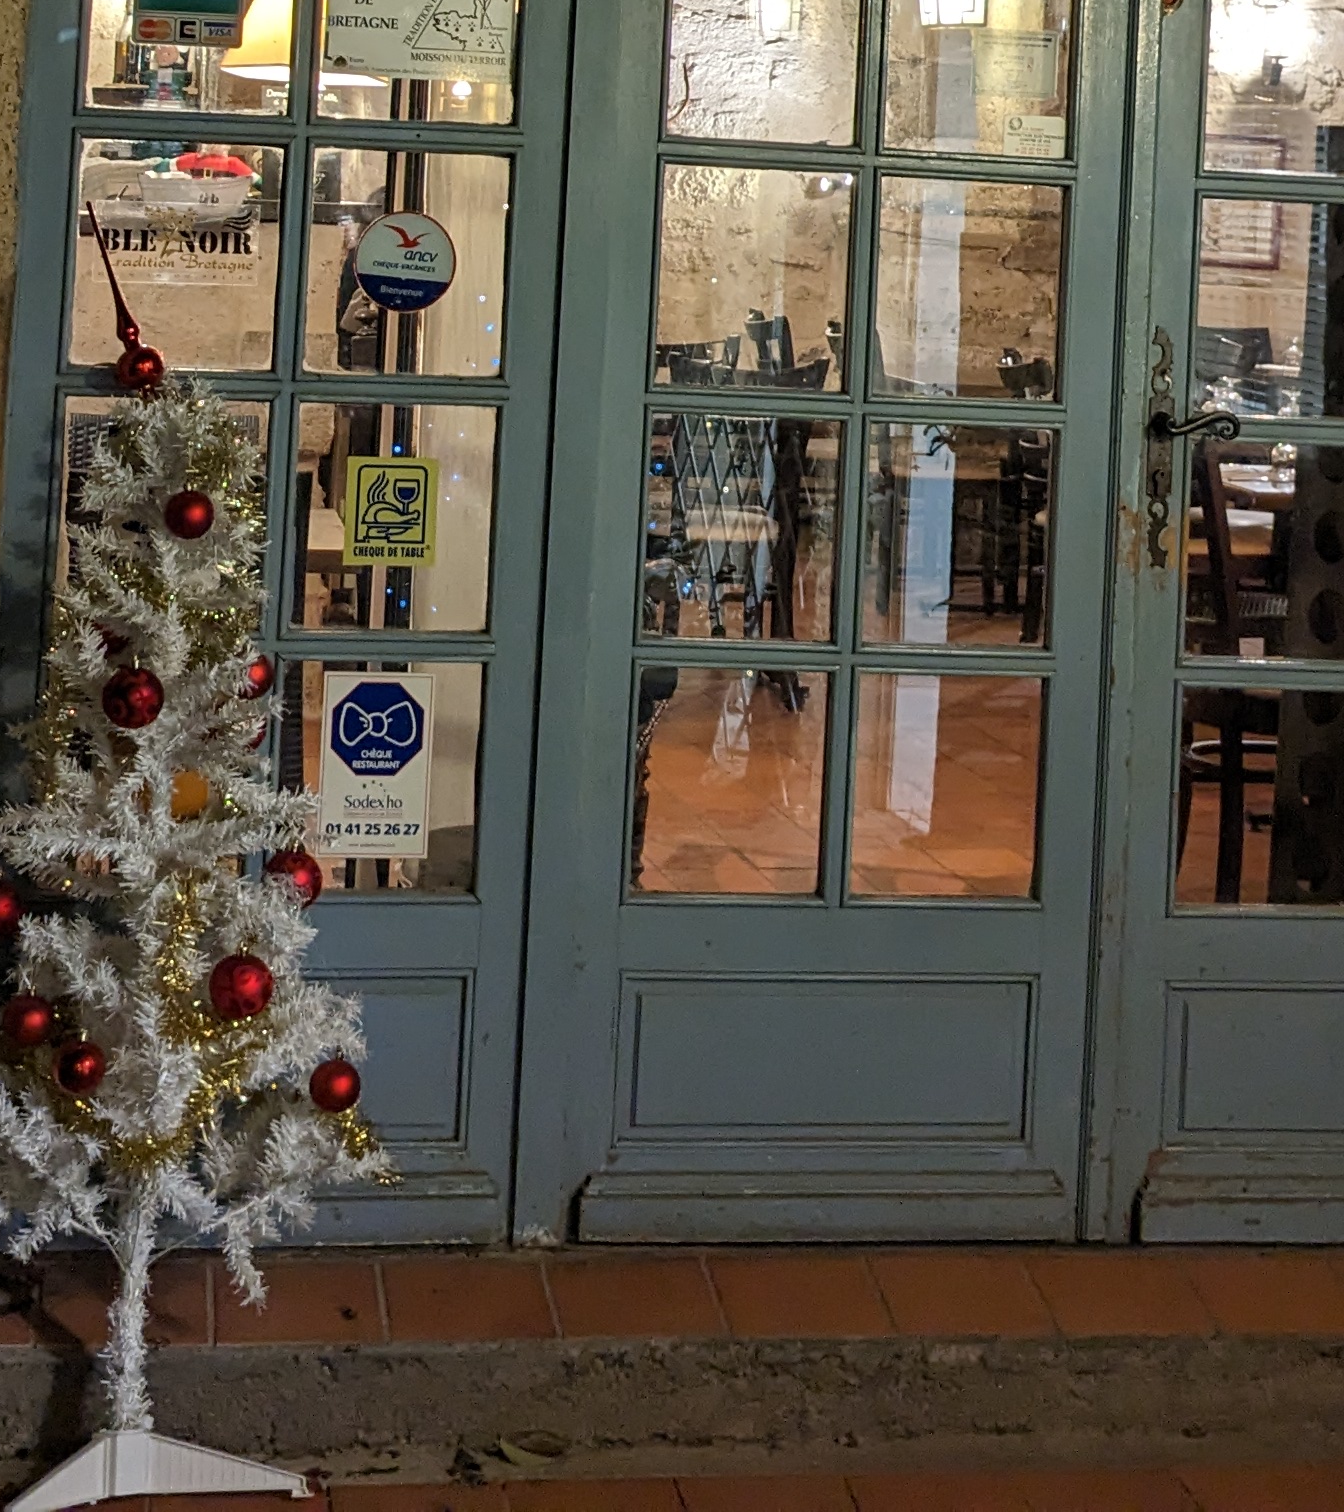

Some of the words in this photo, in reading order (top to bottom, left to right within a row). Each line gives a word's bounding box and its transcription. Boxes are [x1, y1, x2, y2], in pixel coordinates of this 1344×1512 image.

[328, 15, 399, 30] BRETAGNE
[402, 2, 434, 46] TRADITION
[208, 28, 233, 37] VISA
[411, 52, 452, 63] MOISSON
[178, 230, 253, 255] NOIR
[404, 250, 438, 263] ancv
[103, 252, 175, 268] radition
[179, 254, 253, 274] Bretagne
[380, 285, 424, 297] Bienvenue
[353, 546, 385, 557] CHEQUE
[387, 547, 398, 557] DE
[400, 547, 424, 558] TABLE
[361, 748, 392, 759] CHÈQUE
[352, 760, 400, 769] RESTAURANT
[344, 794, 403, 809] Sodexho
[325, 823, 341, 835] 01
[345, 823, 360, 835] 41
[365, 823, 381, 835] 25
[384, 823, 400, 835] 26
[403, 823, 420, 835] 27
